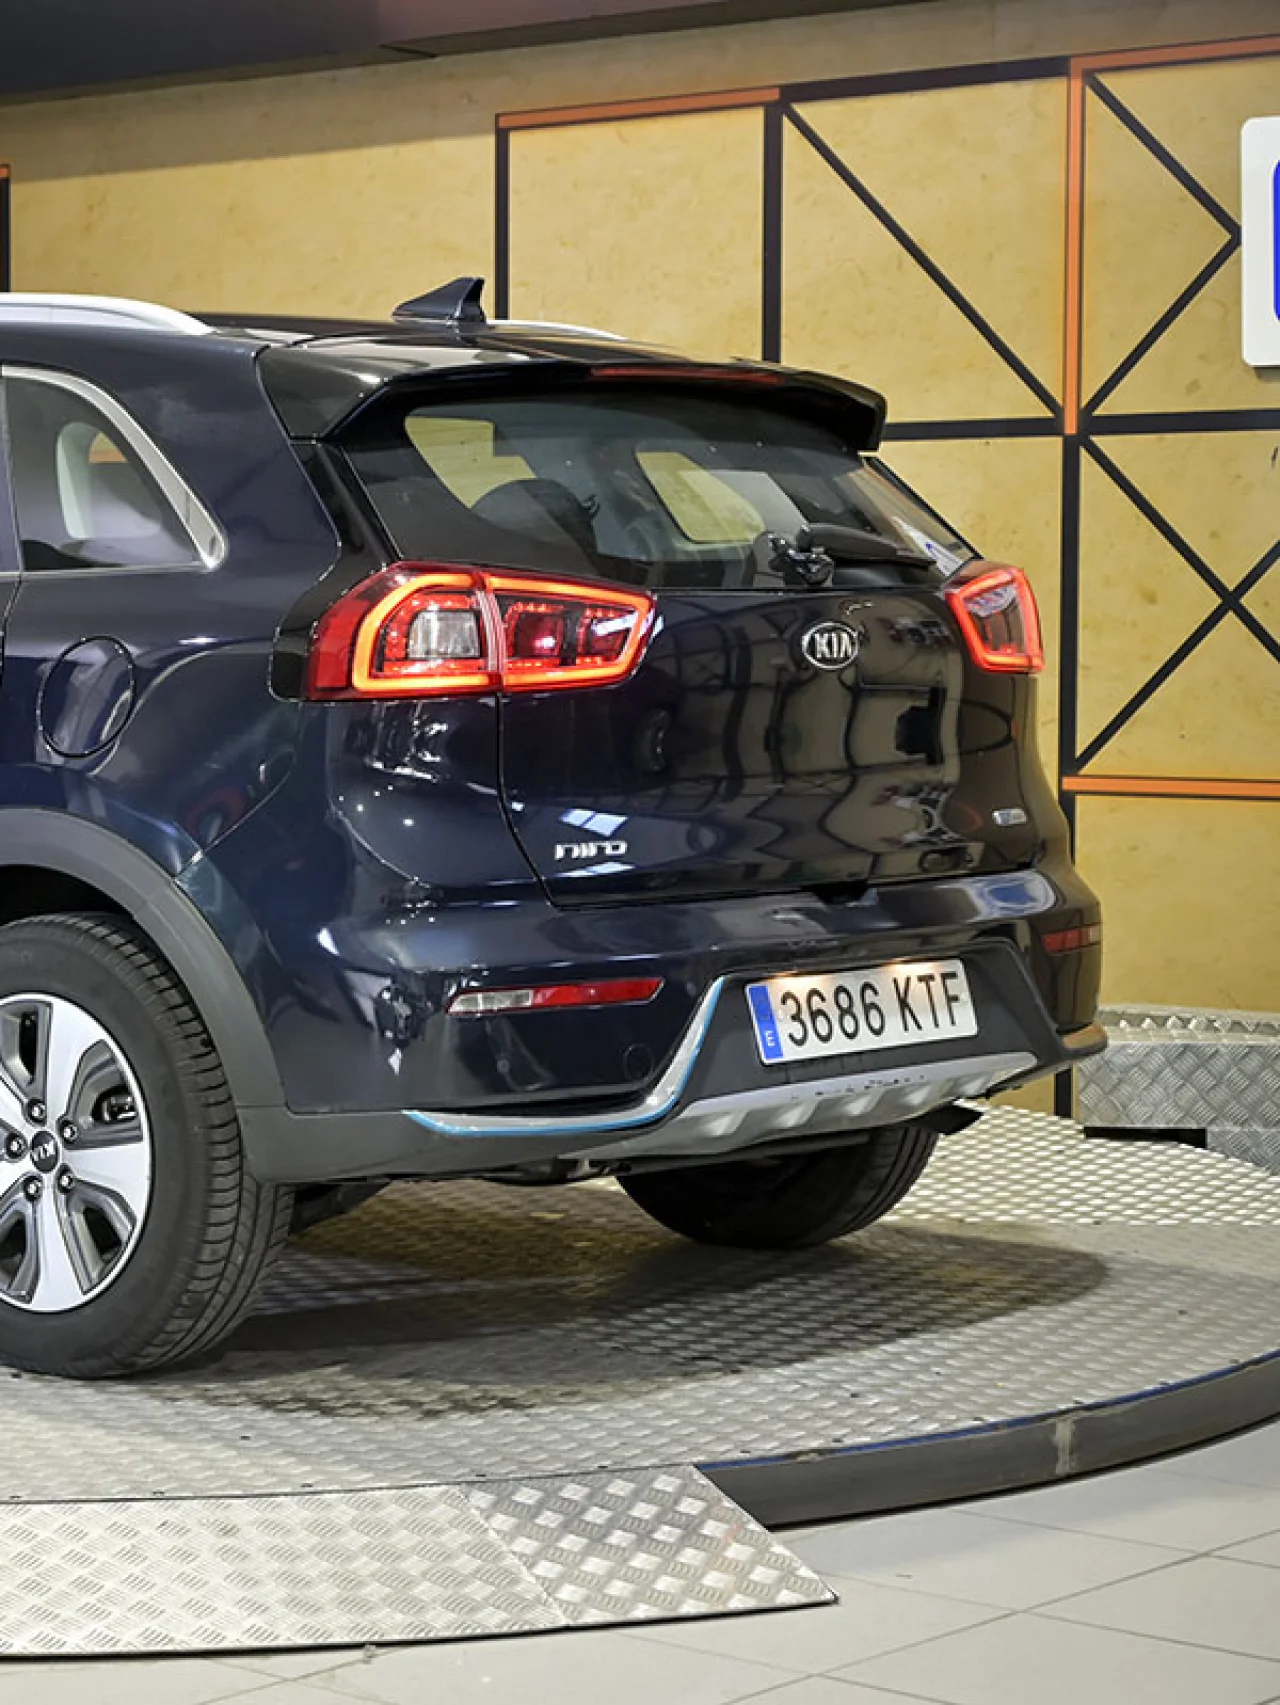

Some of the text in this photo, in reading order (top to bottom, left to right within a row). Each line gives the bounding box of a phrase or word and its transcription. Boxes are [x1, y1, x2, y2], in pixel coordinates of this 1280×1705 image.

[814, 631, 853, 659] KIA
[780, 970, 961, 1047] 3686 KTF
[764, 1029, 776, 1047] E
